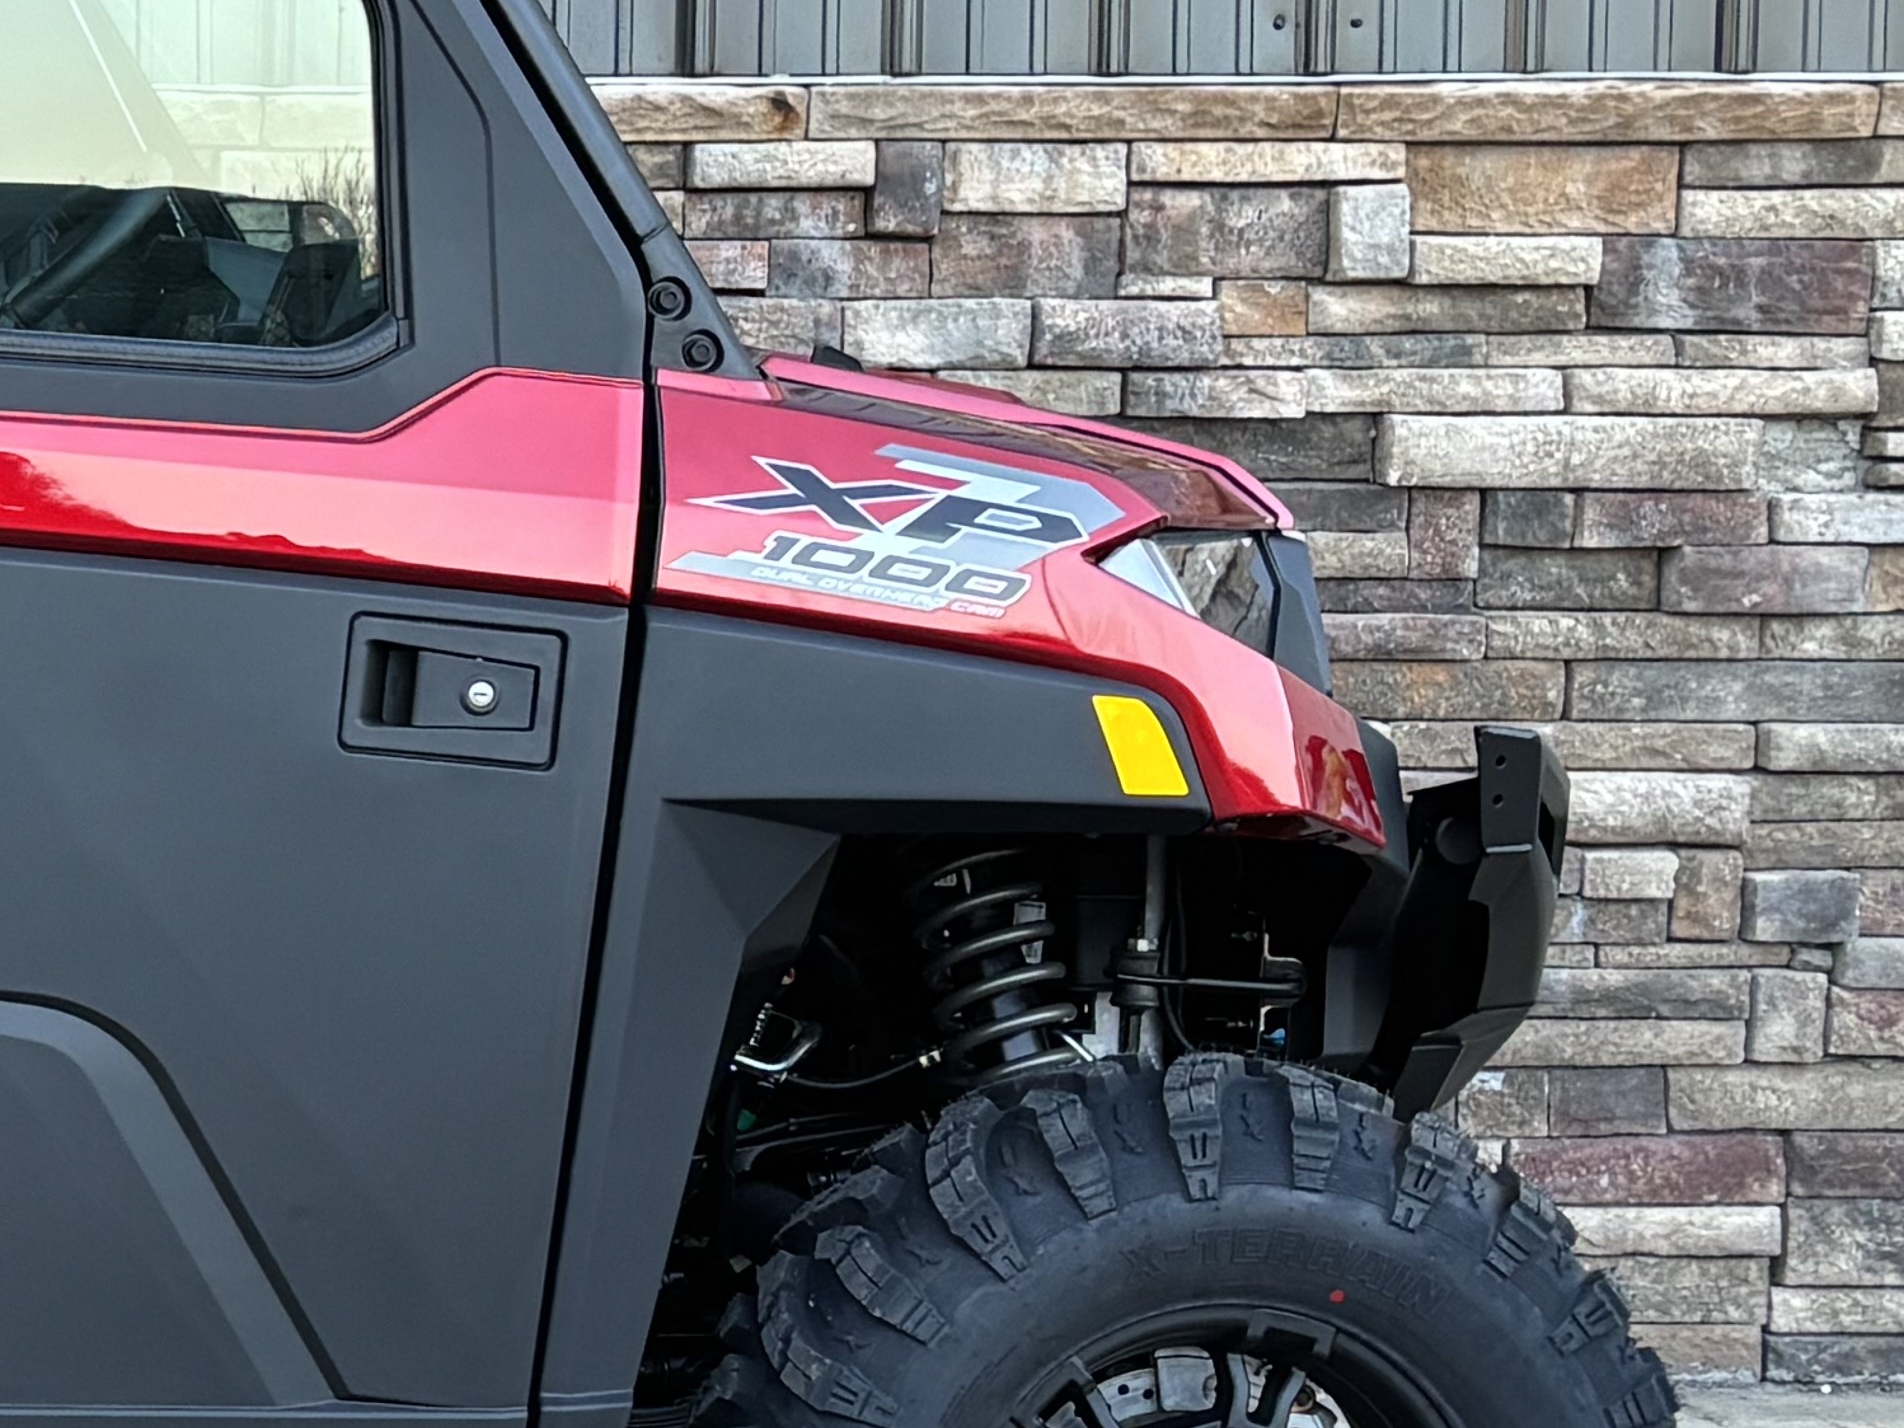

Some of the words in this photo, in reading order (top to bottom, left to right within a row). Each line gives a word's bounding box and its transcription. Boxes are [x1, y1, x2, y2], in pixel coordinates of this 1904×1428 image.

[685, 455, 1092, 546] XP
[761, 532, 1031, 605] 1000
[1118, 1226, 1454, 1322] X-TERRAIN
